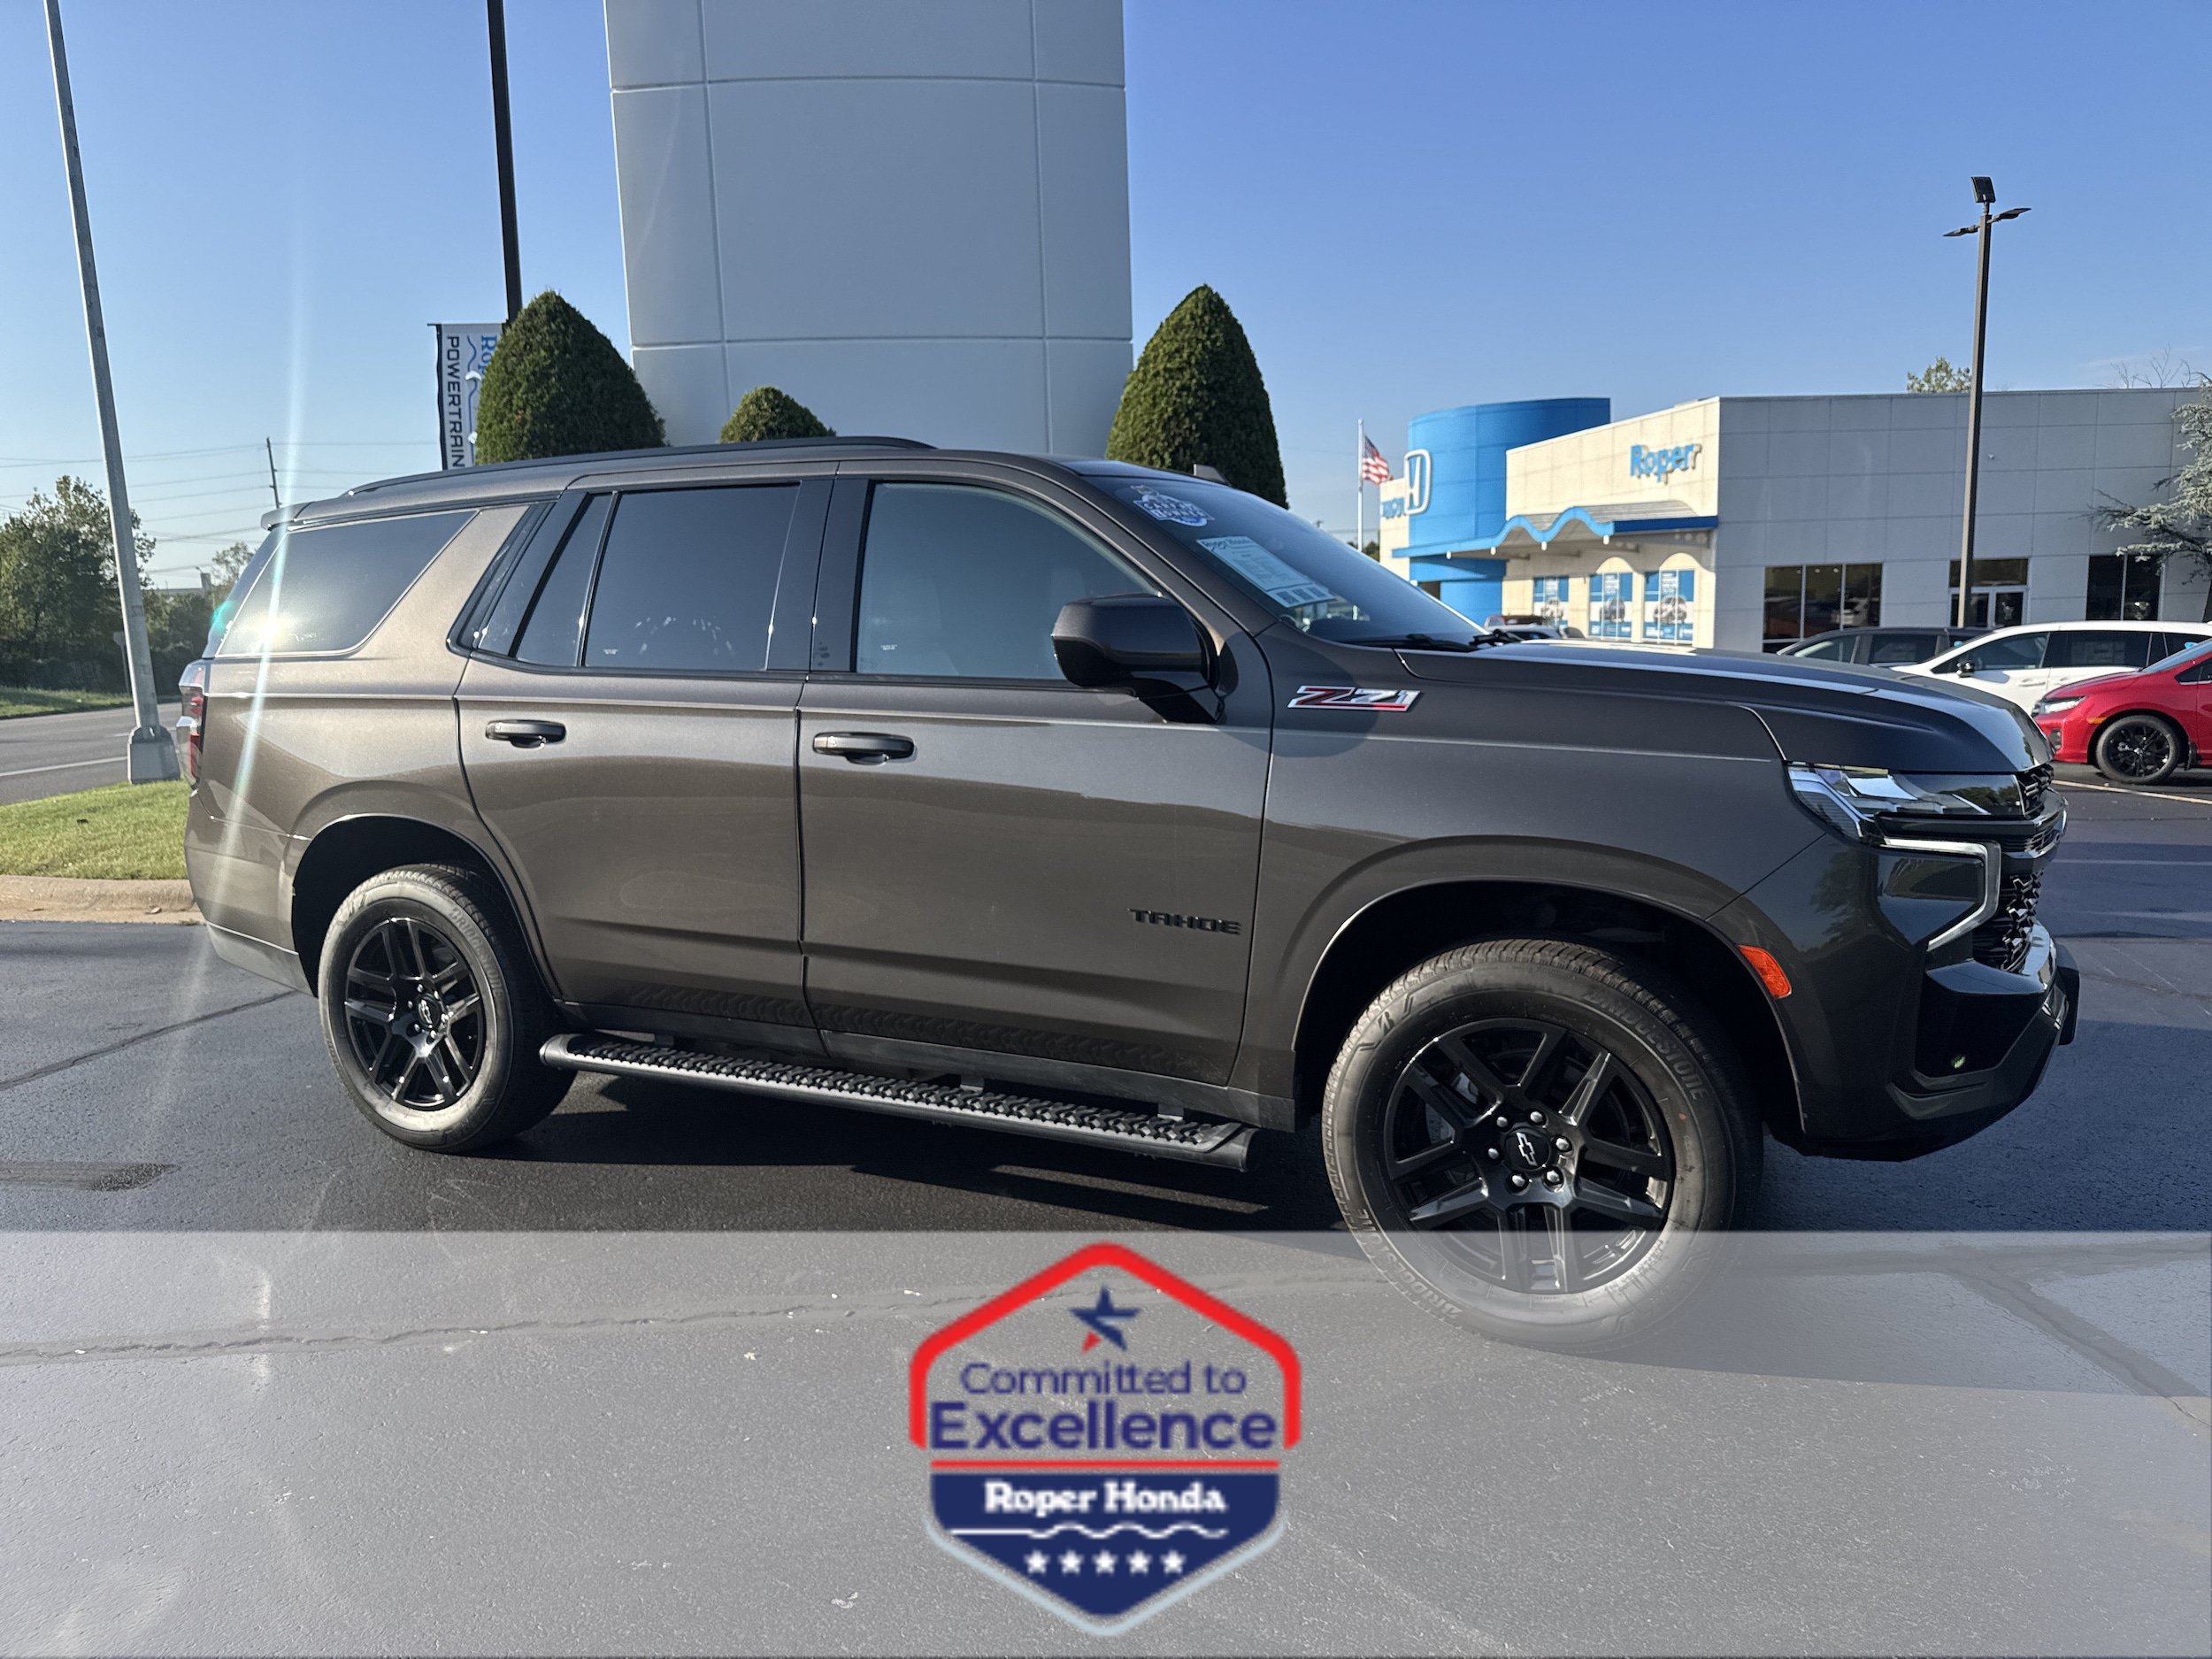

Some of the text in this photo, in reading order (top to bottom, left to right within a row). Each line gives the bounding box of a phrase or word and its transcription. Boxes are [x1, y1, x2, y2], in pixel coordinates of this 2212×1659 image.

[446, 335, 465, 468] POWERTRAIN
[1630, 443, 1697, 484] Roper
[1287, 685, 1421, 712] Z71
[1127, 908, 1241, 935] TAHOE
